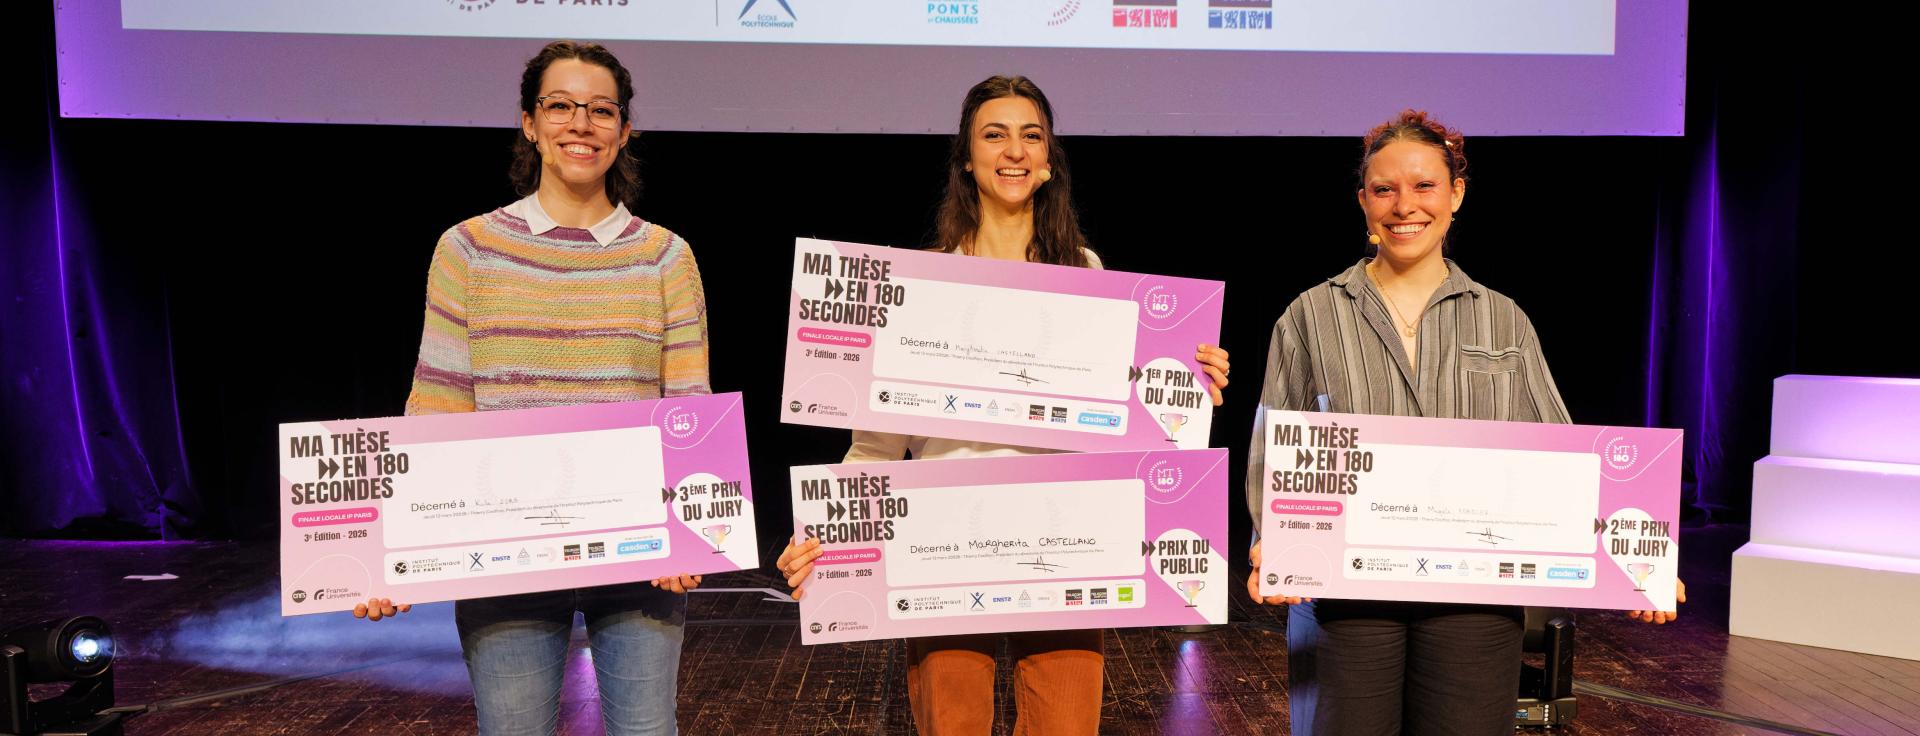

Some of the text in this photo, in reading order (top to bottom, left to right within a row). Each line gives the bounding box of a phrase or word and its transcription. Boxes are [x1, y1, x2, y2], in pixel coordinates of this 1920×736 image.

[928, 4, 978, 14] PONTS
[741, 20, 794, 28] POLYTECHNIQUE
[935, 16, 978, 24] CHAUSSÉES
[803, 252, 891, 282] MA THÈSE
[846, 280, 905, 306] EN 180
[1153, 294, 1170, 304] MT
[799, 299, 888, 328] SECONDES
[900, 337, 949, 350] Décerné à
[814, 348, 837, 359] Édition
[843, 352, 860, 362] 2026
[1145, 368, 1194, 388] 1ER PRIX
[1145, 387, 1204, 409] DU JURY
[672, 414, 690, 424] MT
[674, 423, 690, 431] 180
[290, 427, 390, 458] MA THÈSE
[1274, 421, 1358, 449] MA THÈSE
[1614, 445, 1630, 454] MT
[343, 453, 409, 478] EN 180
[1316, 450, 1374, 472] EN 180
[1158, 468, 1174, 478] MT
[291, 477, 394, 505] SECONDES
[680, 481, 742, 502] 3ÈME PRIX
[801, 472, 891, 500] MA THÈSE
[1272, 470, 1358, 495] SECONDES
[411, 500, 456, 512] Décerné
[460, 499, 466, 508] à
[683, 500, 742, 522] DU JURY
[850, 497, 908, 520] EN 180
[1370, 502, 1410, 512] Décerné
[804, 520, 894, 544] SECONDES
[1288, 520, 1310, 530] Édition
[1316, 522, 1332, 530] 2026
[1610, 518, 1670, 538] 2ÈME PRIX
[314, 532, 341, 542] Édition
[348, 530, 368, 538] 2026
[1038, 538, 1096, 546] CASTELLANO
[910, 544, 960, 554] Décerné à
[1158, 539, 1210, 556] PRIX DU
[1612, 538, 1668, 558] DU JURY
[826, 570, 850, 579] Édition
[856, 569, 872, 577] 2026
[1160, 557, 1208, 575] PUBLIC
